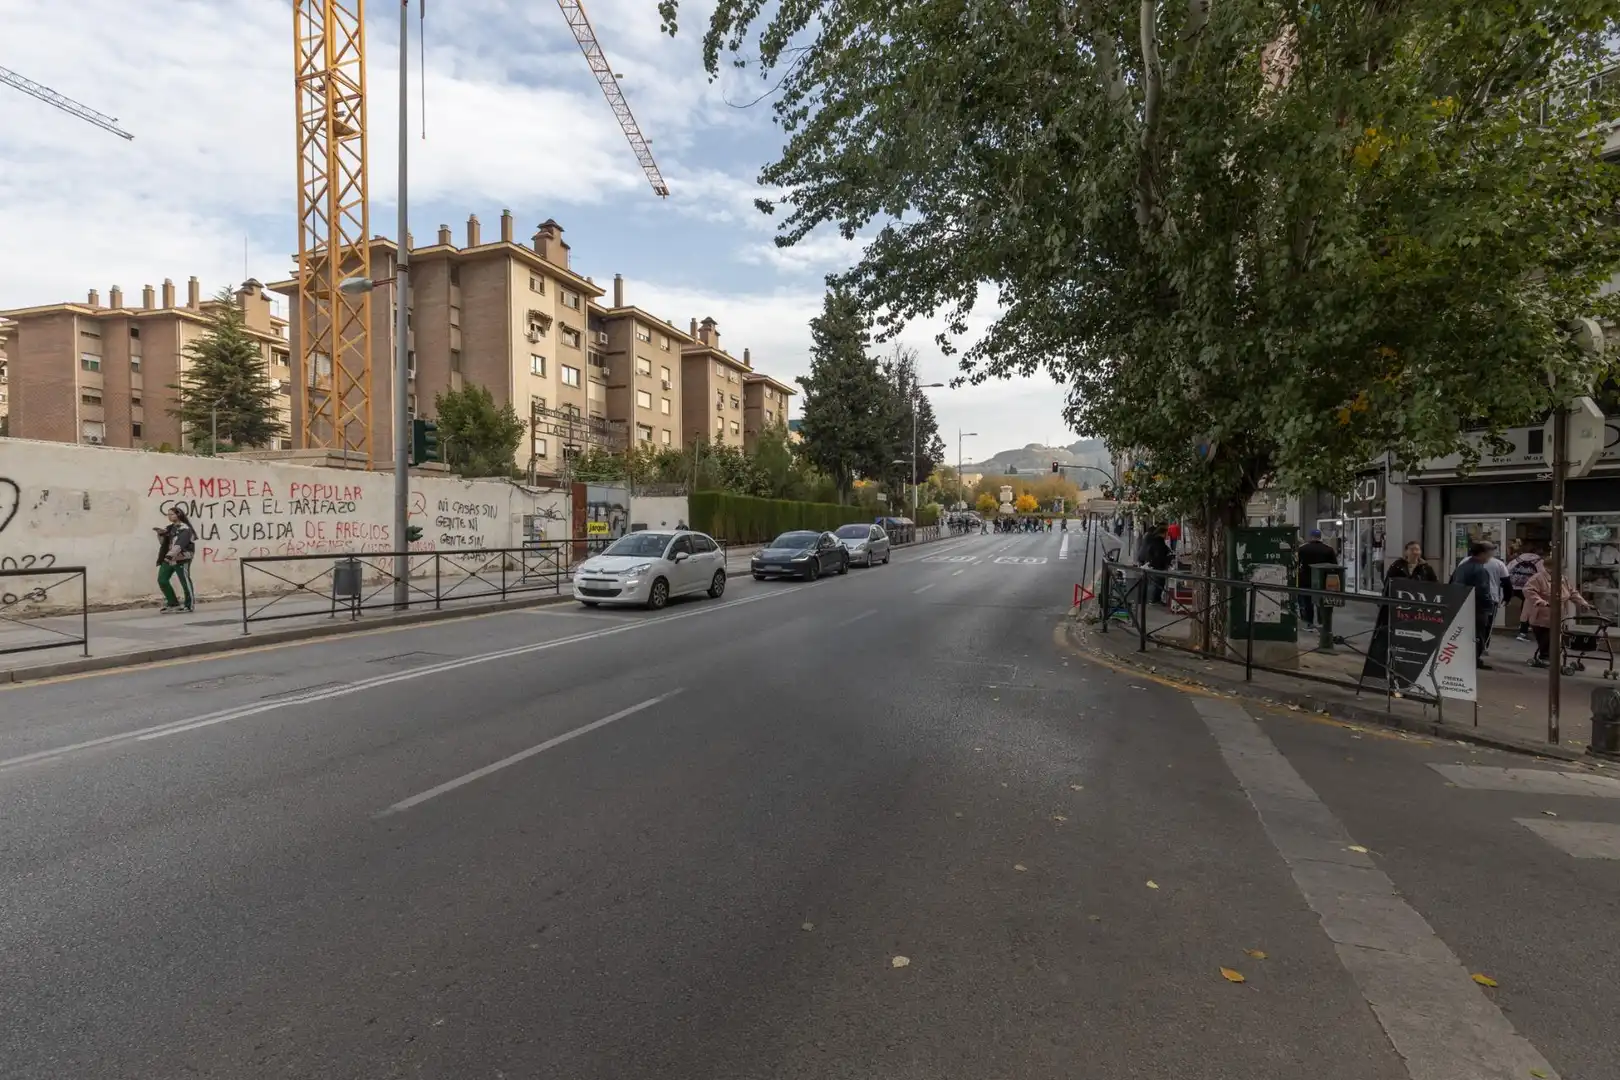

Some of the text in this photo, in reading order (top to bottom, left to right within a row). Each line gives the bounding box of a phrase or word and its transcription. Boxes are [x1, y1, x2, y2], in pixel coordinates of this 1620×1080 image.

[148, 474, 363, 501] ASAMBLEA POPULAR
[159, 498, 356, 518] CONTRA EL TARIFAZO
[200, 522, 221, 541] LA
[230, 521, 294, 541] SUBIDA
[305, 520, 325, 540] DE
[1438, 642, 1459, 665] SIN
